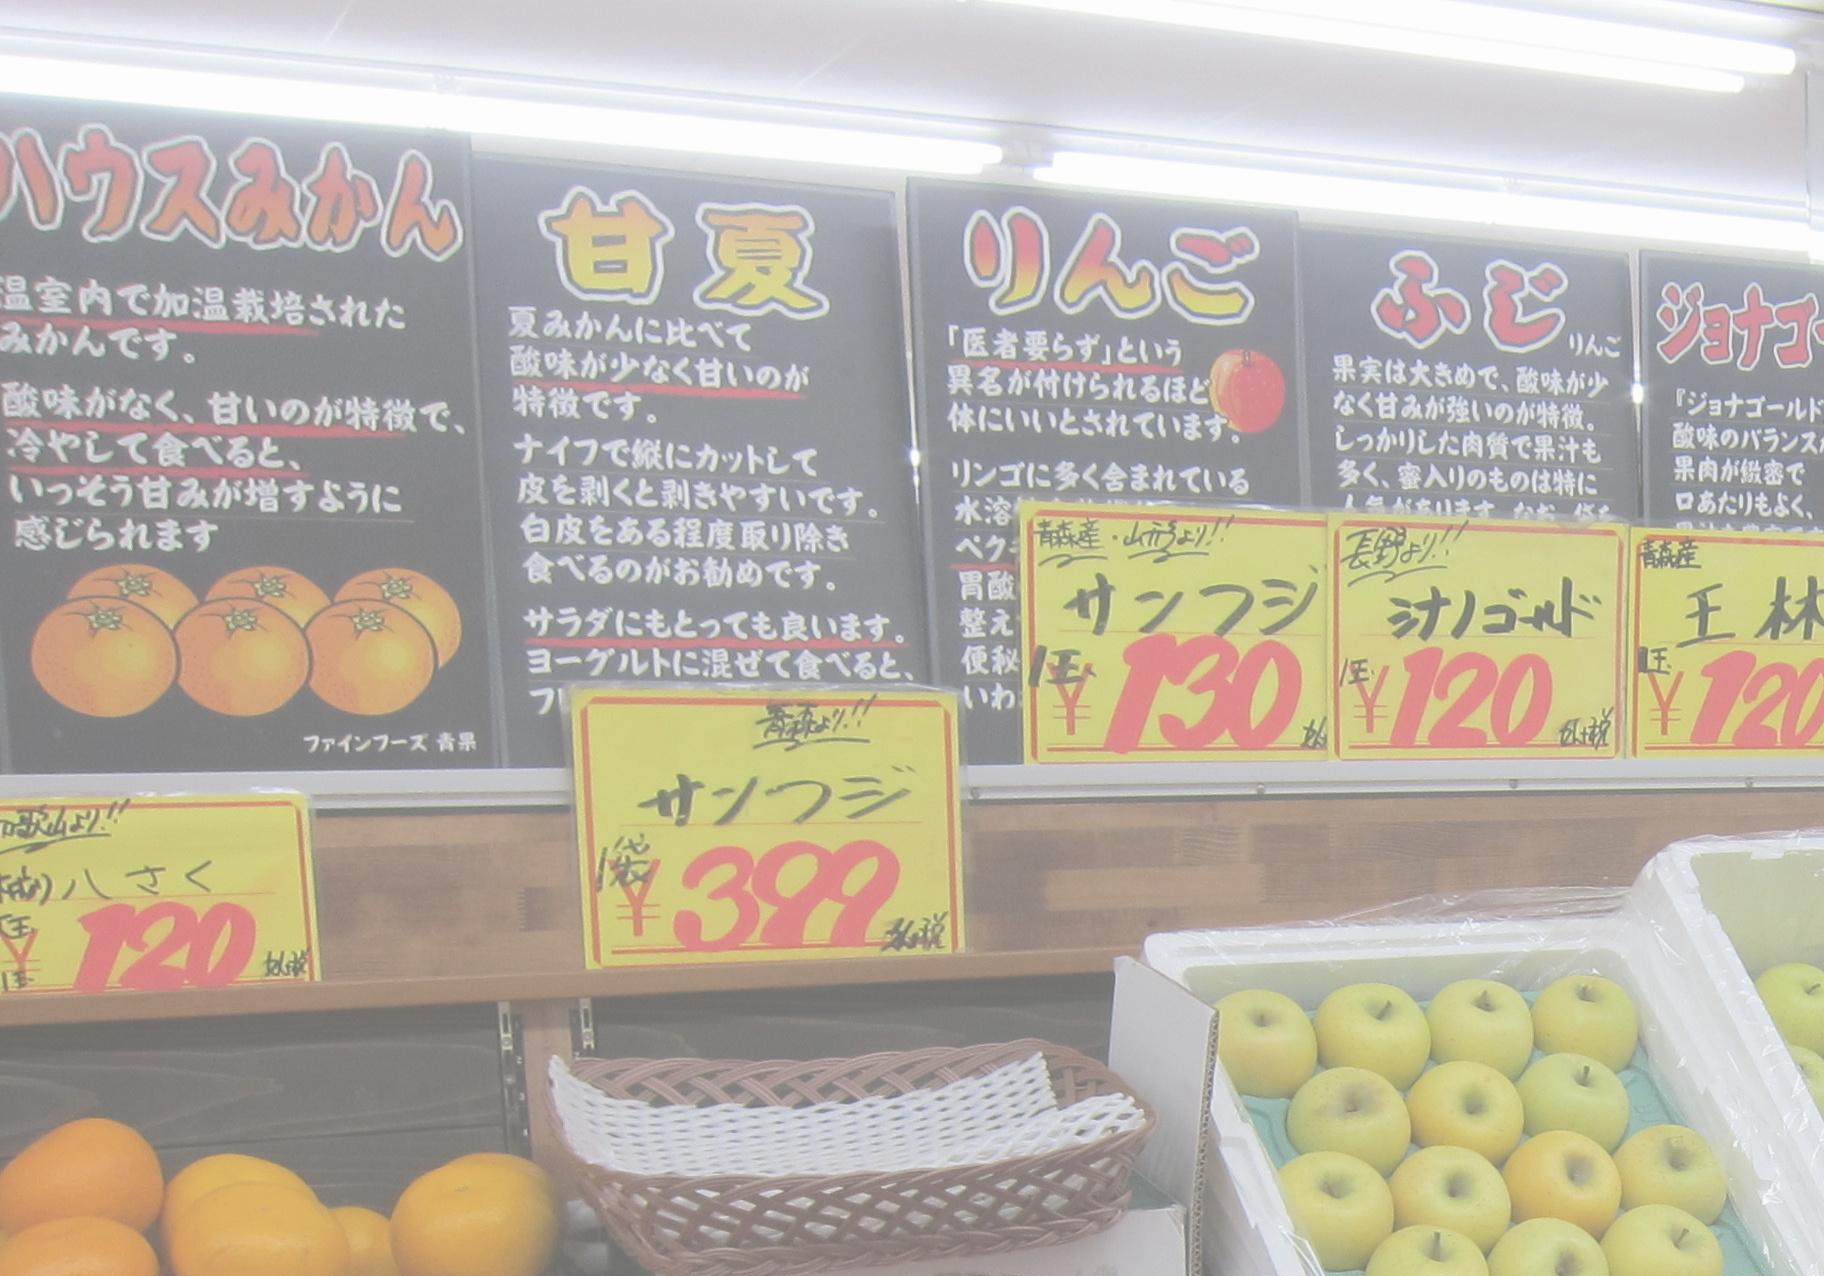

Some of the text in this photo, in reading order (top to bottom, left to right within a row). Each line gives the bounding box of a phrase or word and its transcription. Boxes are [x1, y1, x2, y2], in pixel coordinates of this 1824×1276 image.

[0, 124, 463, 261] ハウスみかん
[537, 184, 830, 320] 甘夏
[964, 205, 1260, 325] りんご
[0, 276, 405, 329] 温室内で加温栽培された
[1371, 249, 1621, 358] ふじ りんご
[1, 322, 195, 364] みかんです。
[508, 305, 752, 351] 夏みかんに比べて
[947, 324, 1182, 367] 「医者要らず」という
[510, 345, 810, 392] 酸味が少なく甘いのが
[947, 364, 1211, 405] 異名が付けられるほど
[1333, 354, 1609, 399] 果実は大きめで、酸味が少
[2, 382, 466, 434] 酸味がなく、甘いのが特徴で、
[512, 385, 658, 424] 特徴です。
[947, 402, 1240, 444] 体にいいとされています。
[1334, 390, 1594, 431] なく甘みが強いのが特徴。
[6, 430, 302, 471] 冷やして食べると、
[513, 434, 819, 476] ナイフで縦にカットして
[1336, 424, 1602, 464] しっかりした肉質で果汁も
[951, 459, 1250, 495] リンゴに多く含まれている
[1337, 459, 1598, 496] 多く、蜜入りのものは特に
[1674, 455, 1805, 486] 果肉が緻密で
[8, 474, 402, 513] いっそう甘みが増すように
[517, 472, 879, 519] 皮を剥くと剥きやすいです。
[1675, 491, 1813, 520] 口あたりもよく、
[14, 517, 218, 551] 感じられます
[520, 512, 849, 553] 白皮をある程度取り除き
[522, 552, 836, 592] 食べるのがお勧めです。
[1062, 564, 1325, 636] サンフジ
[527, 648, 914, 682] ヨーグルトに混ぜて食べると、
[303, 731, 478, 753] ファインフーズ 青果
[636, 765, 917, 827] サンフジ
